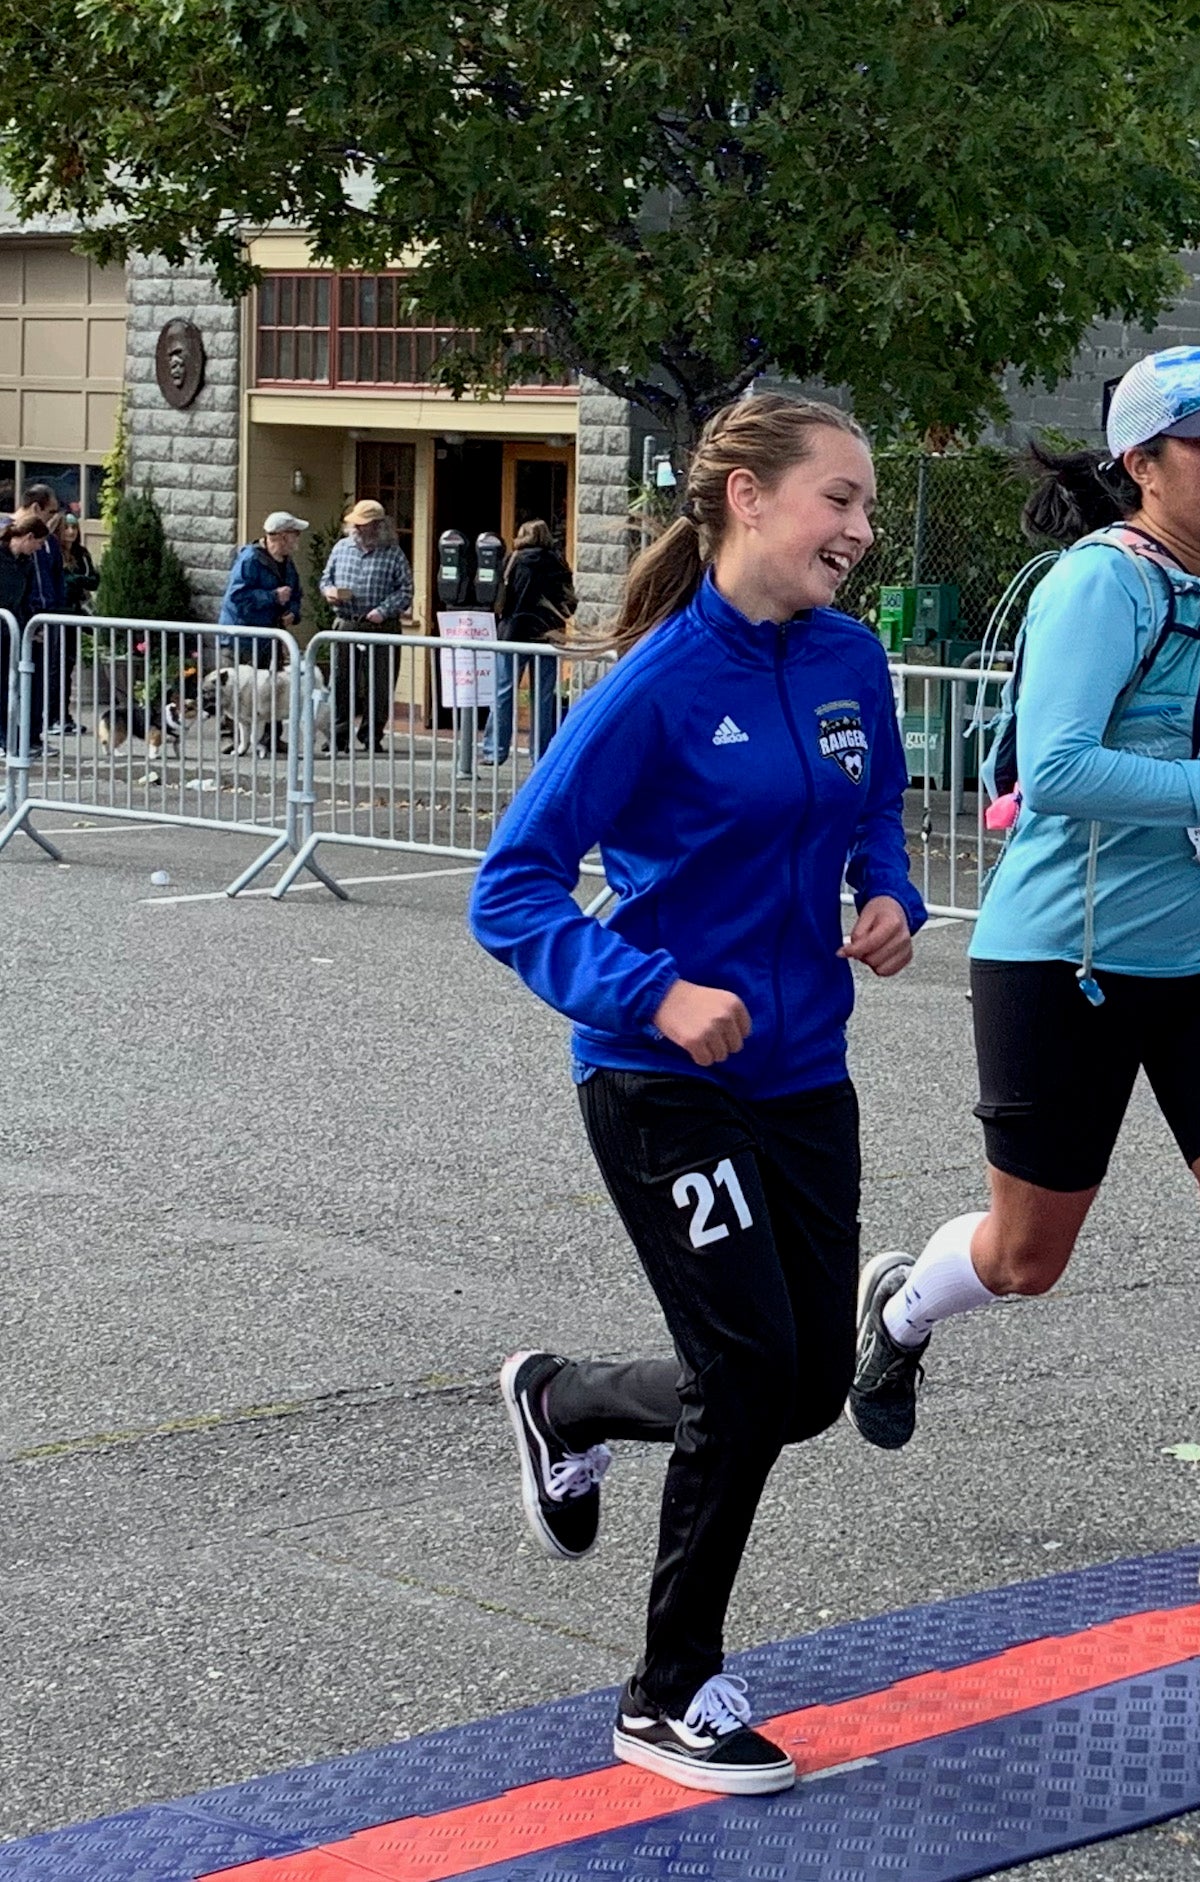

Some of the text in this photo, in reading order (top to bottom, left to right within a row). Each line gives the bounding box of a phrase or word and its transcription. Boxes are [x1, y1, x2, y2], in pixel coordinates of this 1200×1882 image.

[446, 627, 490, 637] PARKING
[712, 732, 750, 746] adidas
[672, 1158, 753, 1249] 21
